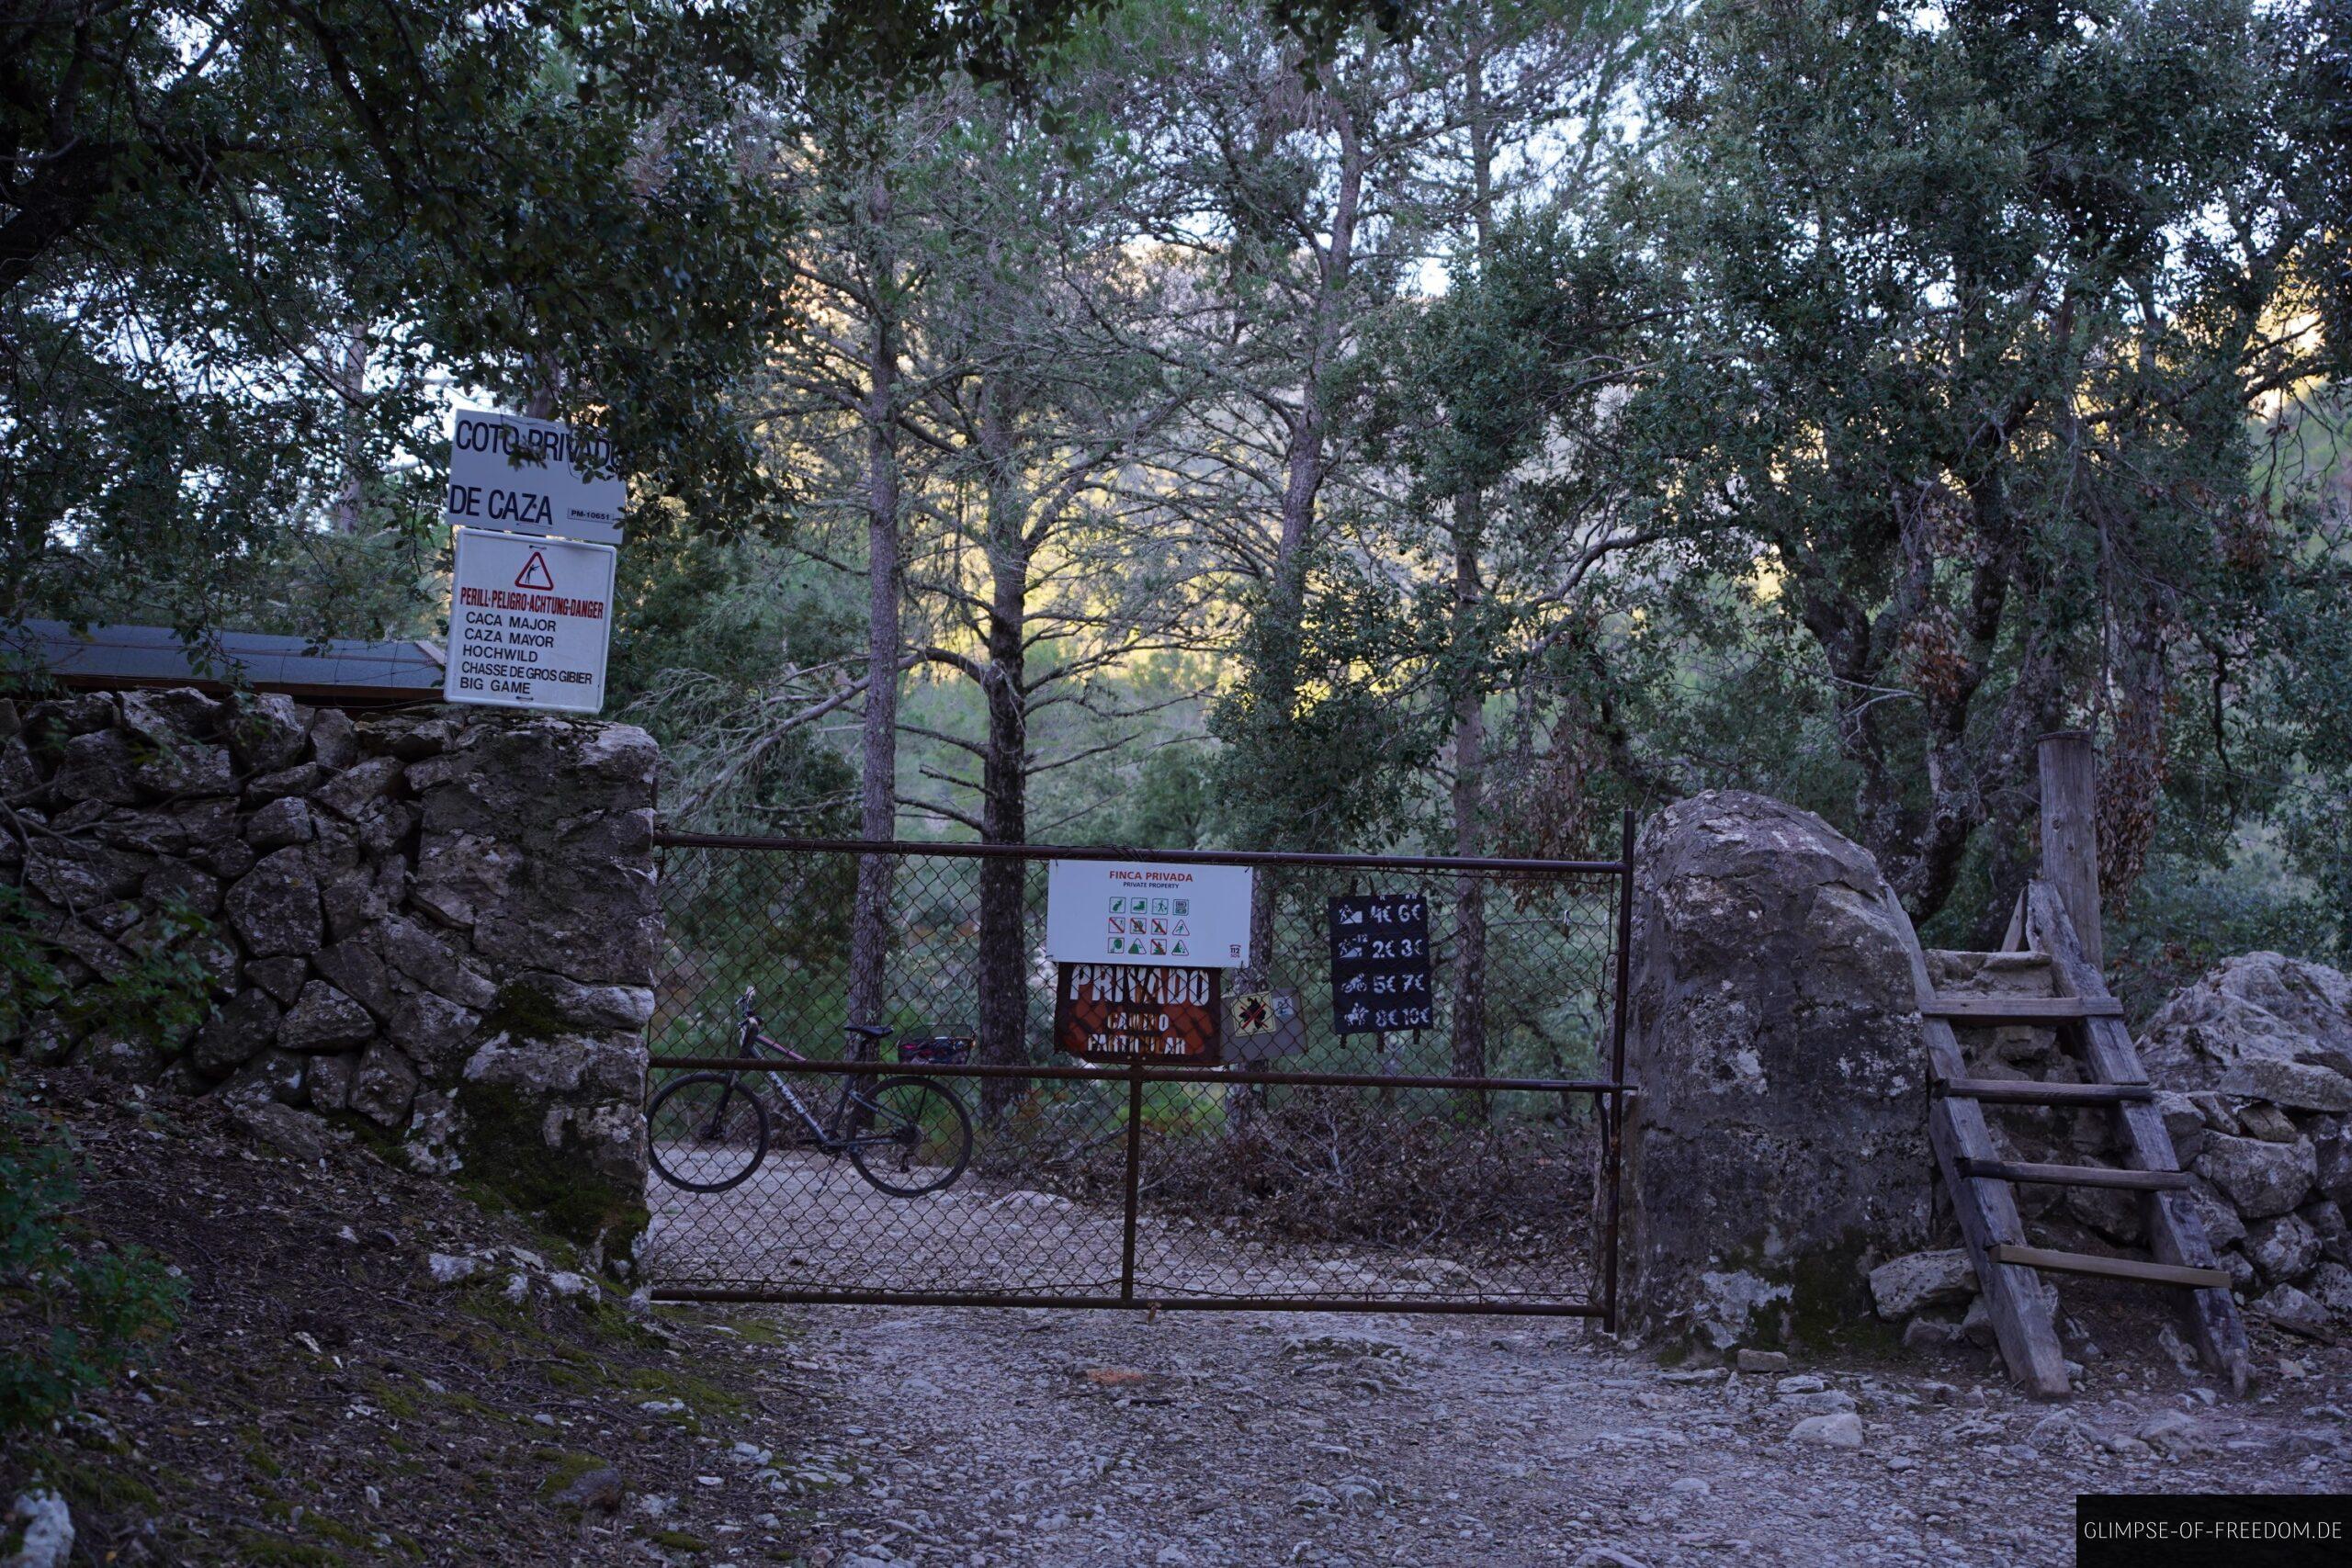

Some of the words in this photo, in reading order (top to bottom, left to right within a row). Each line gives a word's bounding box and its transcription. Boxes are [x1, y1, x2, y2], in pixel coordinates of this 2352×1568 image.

[456, 419, 519, 456] COTO
[448, 484, 481, 517] DE
[488, 489, 552, 525] CAZA
[509, 616, 556, 632] MAJOR
[464, 627, 502, 643] CAZA
[509, 632, 554, 648] MAYOR
[462, 644, 538, 662] HOCHWILD
[461, 661, 507, 677] CHASSE
[509, 666, 524, 678] DE
[526, 667, 557, 682] GROS
[559, 670, 593, 684] GIBIER
[459, 677, 483, 690] BIG
[490, 680, 531, 694] GAME
[1109, 870, 1143, 880] FINCA
[1146, 872, 1193, 882] PRIVADA
